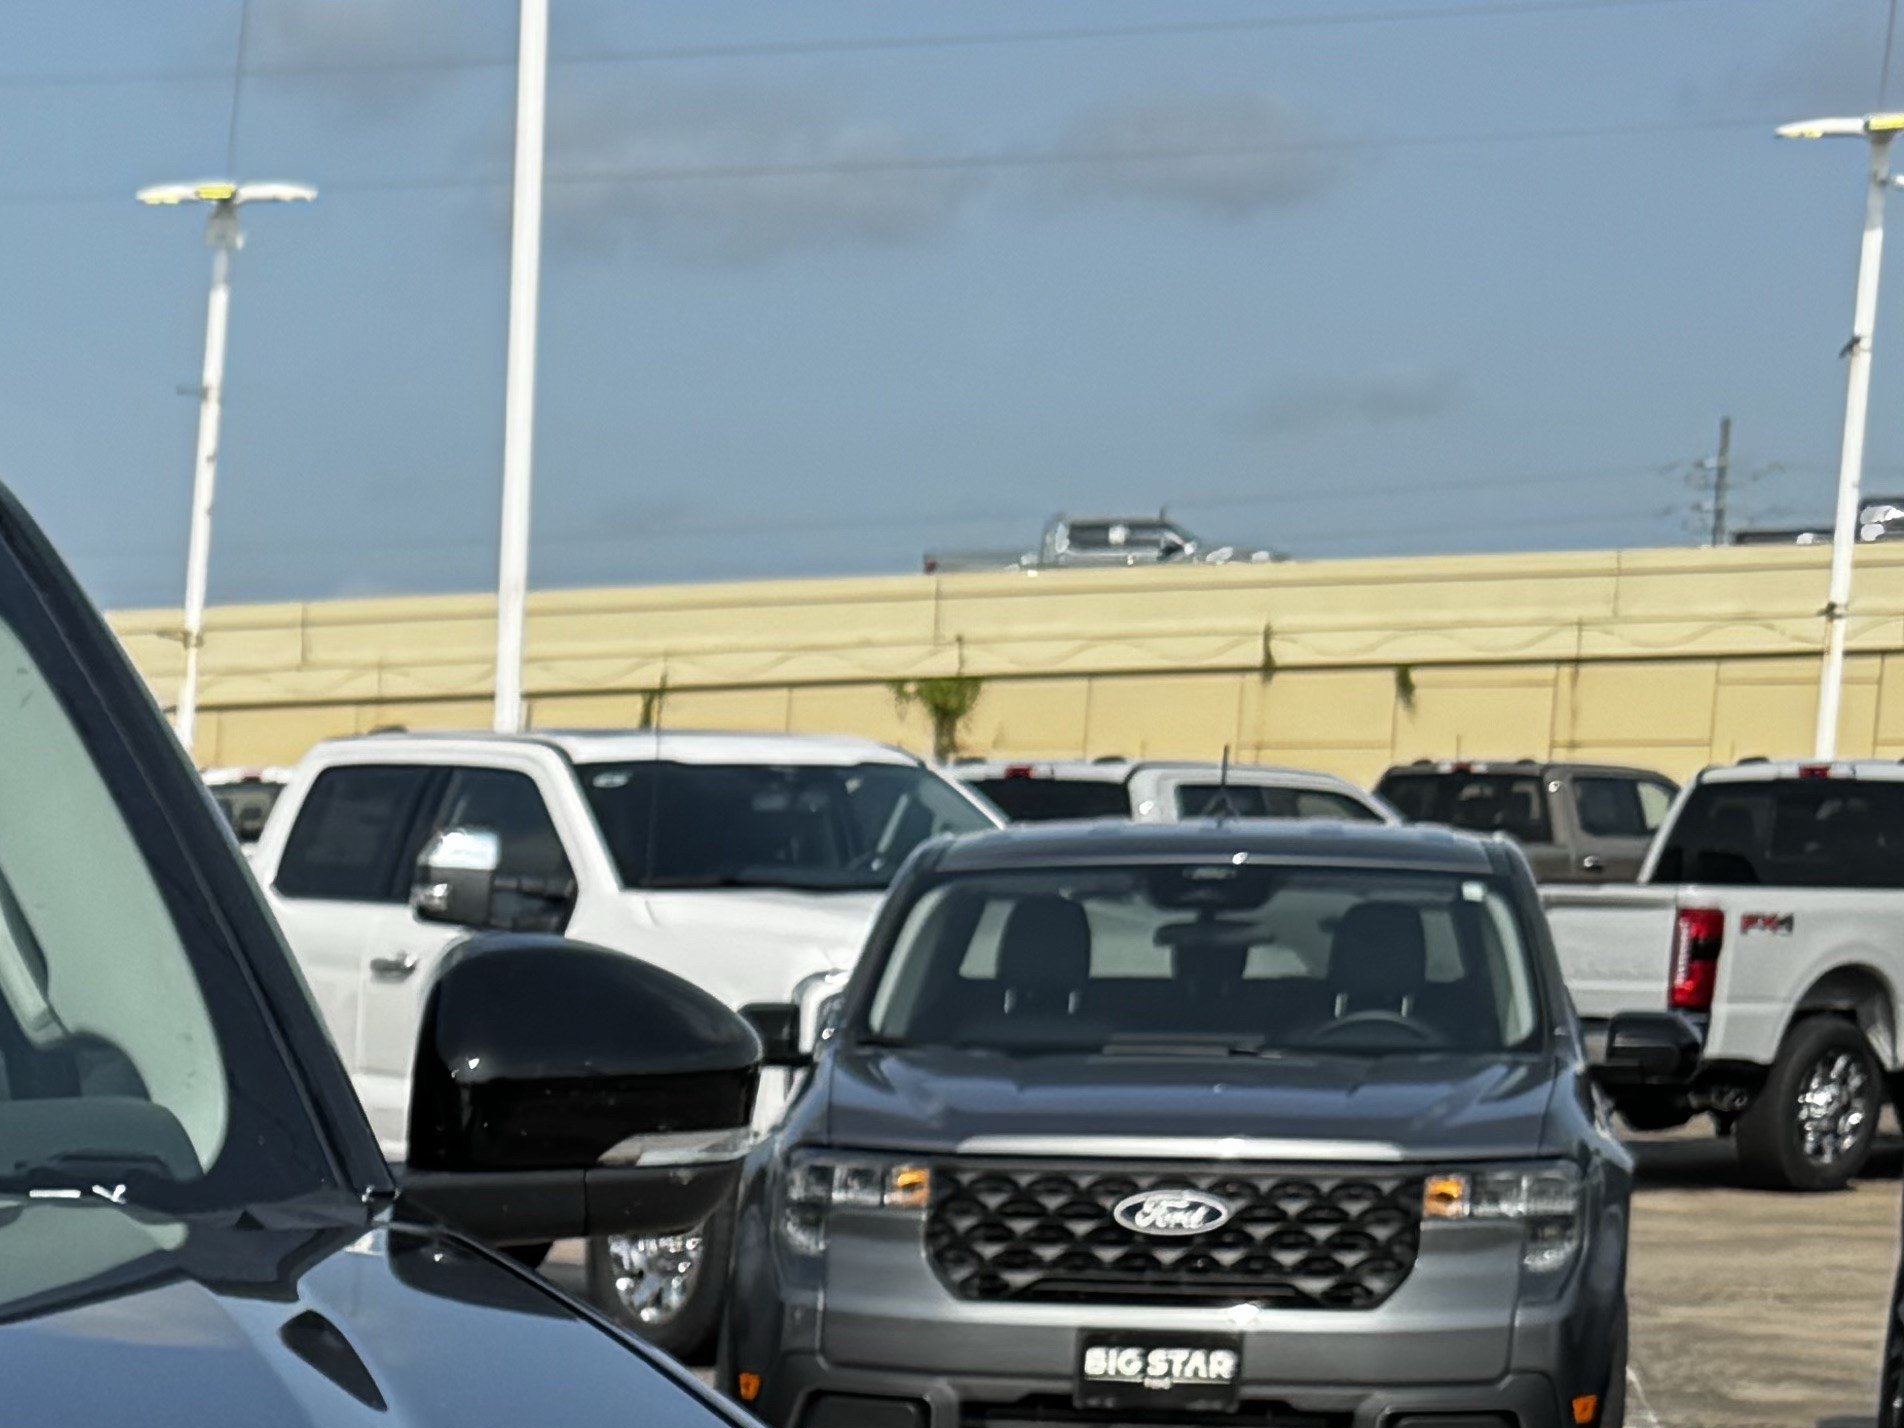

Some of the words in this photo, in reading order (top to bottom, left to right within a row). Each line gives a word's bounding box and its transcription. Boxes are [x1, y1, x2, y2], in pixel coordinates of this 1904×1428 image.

[1134, 1198, 1209, 1229] Ford
[1084, 1347, 1142, 1376] BIG
[1147, 1348, 1236, 1379] STAR
